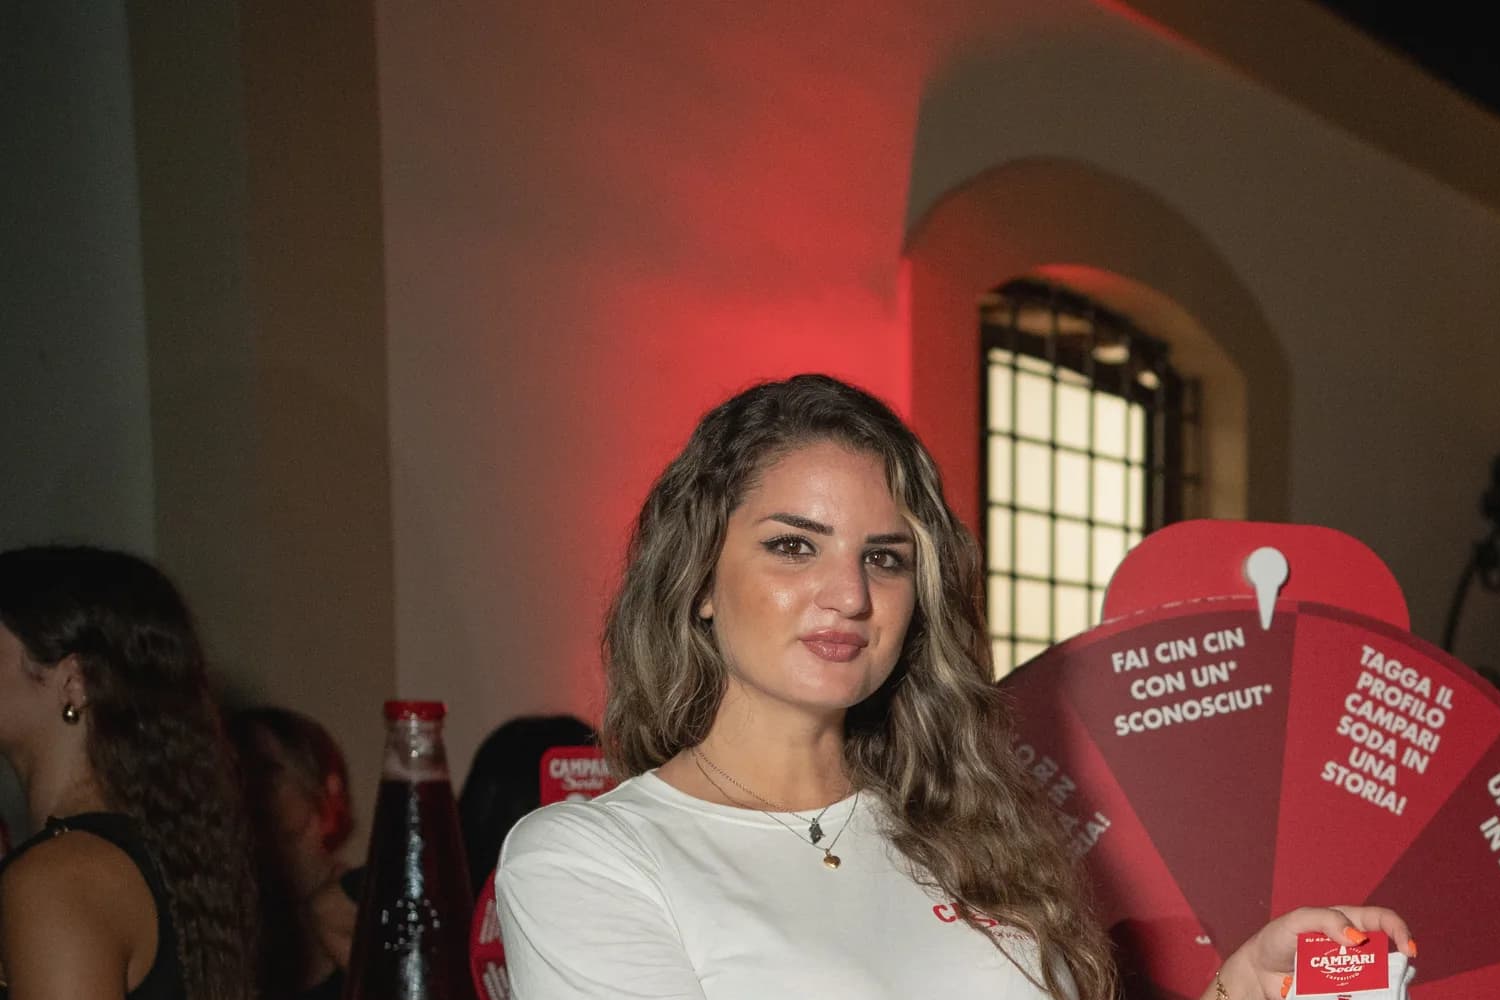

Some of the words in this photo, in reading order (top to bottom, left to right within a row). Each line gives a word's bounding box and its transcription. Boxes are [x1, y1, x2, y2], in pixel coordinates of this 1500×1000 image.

[1112, 647, 1149, 673] FAI
[1154, 637, 1198, 664] CIN
[1203, 627, 1245, 653] CIN
[1131, 671, 1186, 700] CON
[1356, 671, 1445, 729] PROFILO
[1360, 645, 1431, 698] TAGGA
[1435, 685, 1453, 710] IL
[1336, 715, 1397, 760] SODA
[1401, 747, 1429, 774] IN
[1344, 693, 1440, 753] CAMPARI
[1320, 761, 1407, 816] STORIA!
[1348, 747, 1397, 786] UNA
[1310, 953, 1375, 968] CAMPARI
[1320, 964, 1363, 974] Soda
